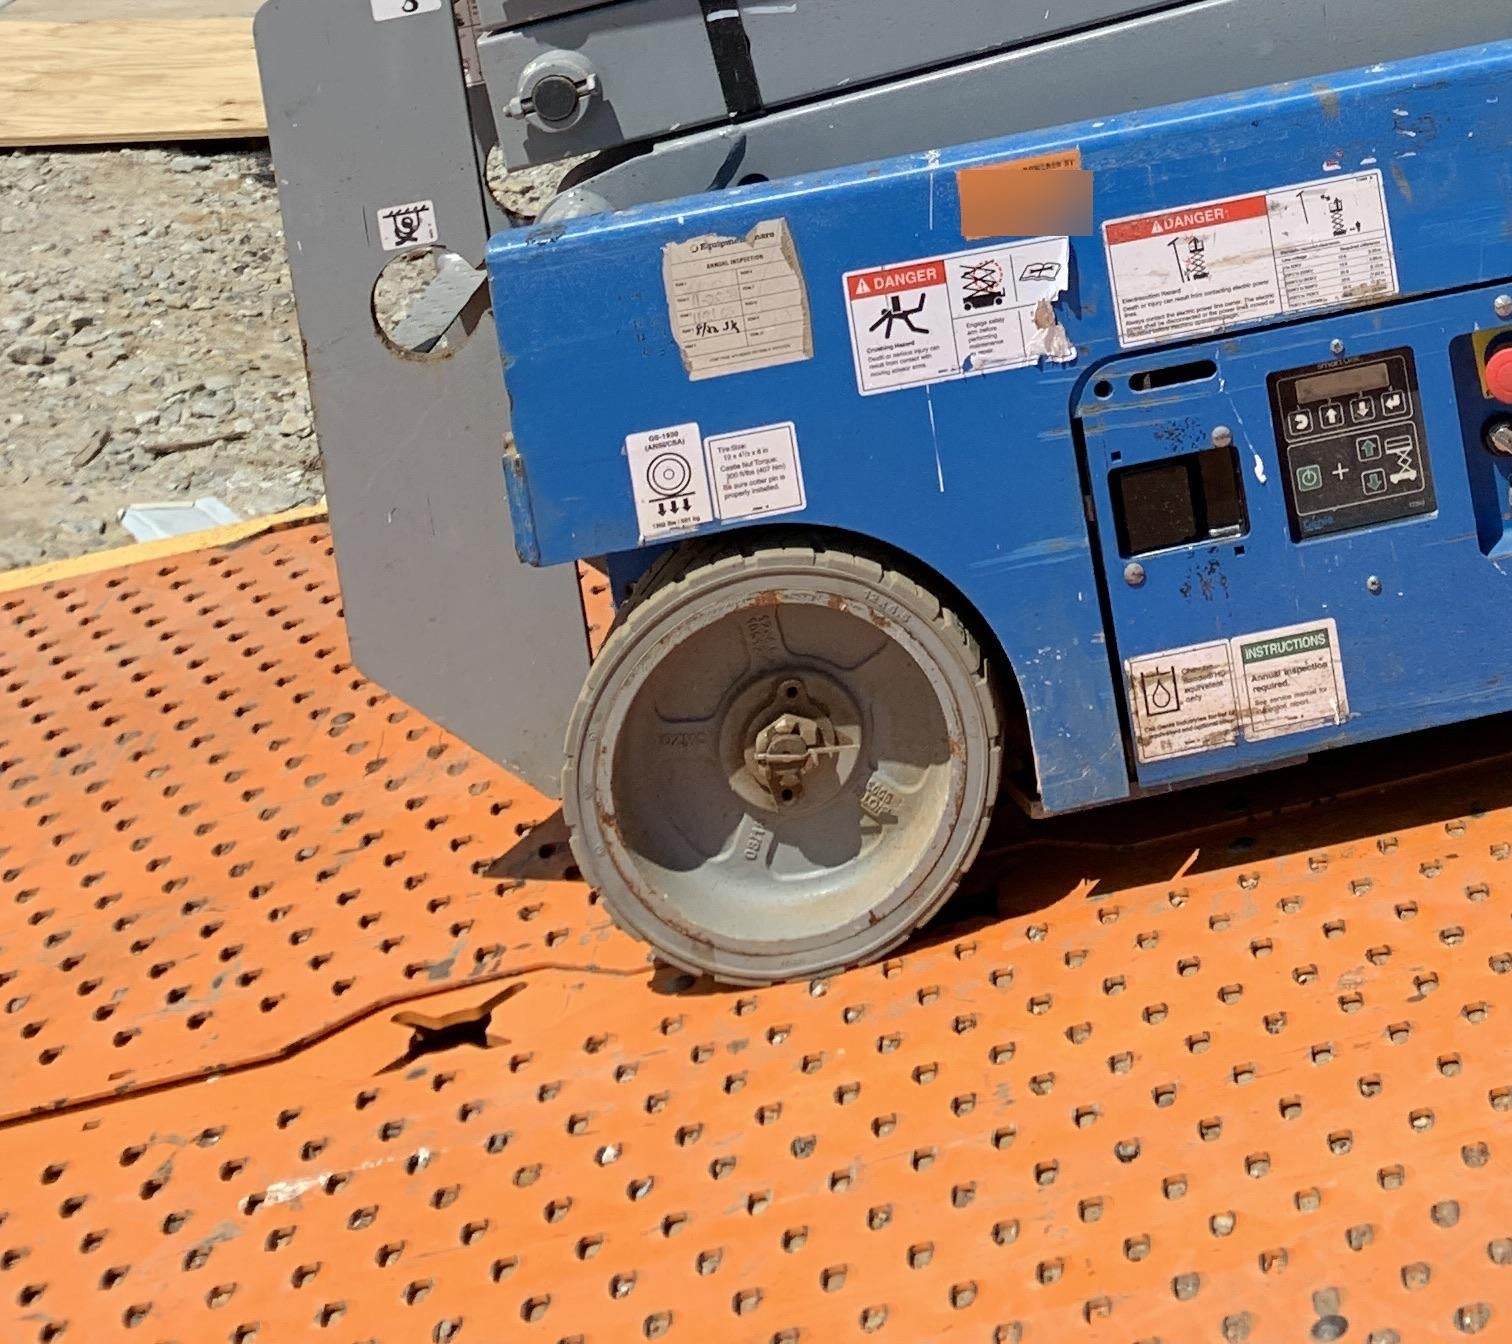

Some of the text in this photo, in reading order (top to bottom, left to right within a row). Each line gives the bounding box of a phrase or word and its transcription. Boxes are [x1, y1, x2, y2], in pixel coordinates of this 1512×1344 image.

[1162, 207, 1225, 230] DANGER
[705, 253, 763, 269] ANNUAL INSPECTION
[872, 267, 937, 290] DANGER
[647, 430, 679, 442] GS-1930
[1243, 632, 1327, 660] INSTRUCTIONS
[1250, 659, 1329, 683] Annual inspection
[1183, 679, 1224, 694] equivalent
[1251, 678, 1290, 695] required.
